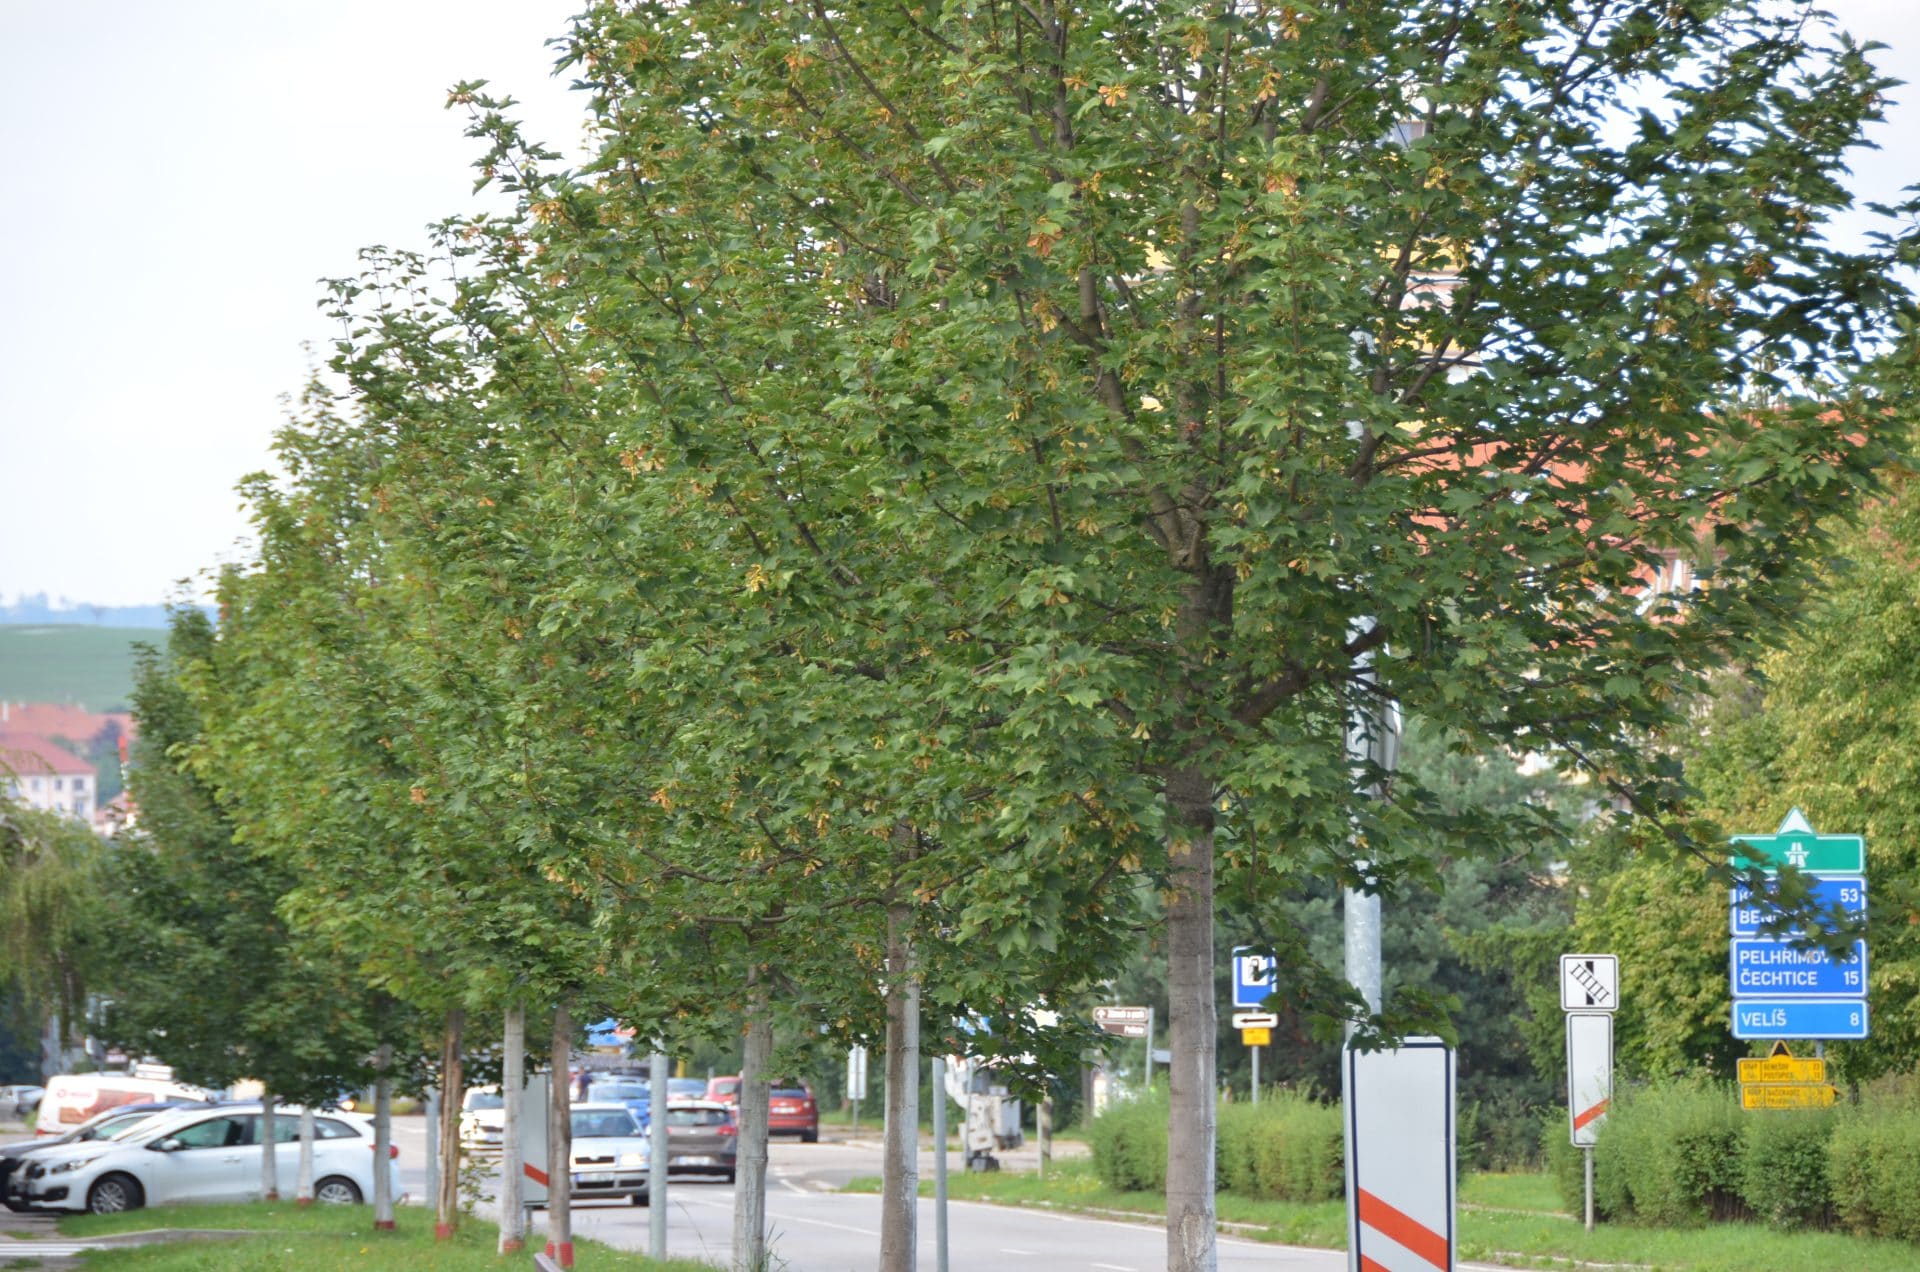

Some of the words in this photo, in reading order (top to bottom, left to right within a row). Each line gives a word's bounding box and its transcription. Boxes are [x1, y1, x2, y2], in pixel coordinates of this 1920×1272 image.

[1840, 888, 1859, 903] 53
[1740, 967, 1818, 986] ČECHTICE
[1843, 971, 1859, 986] 15
[1741, 1007, 1787, 1027] VELÍŠ
[1849, 1012, 1860, 1027] 8
